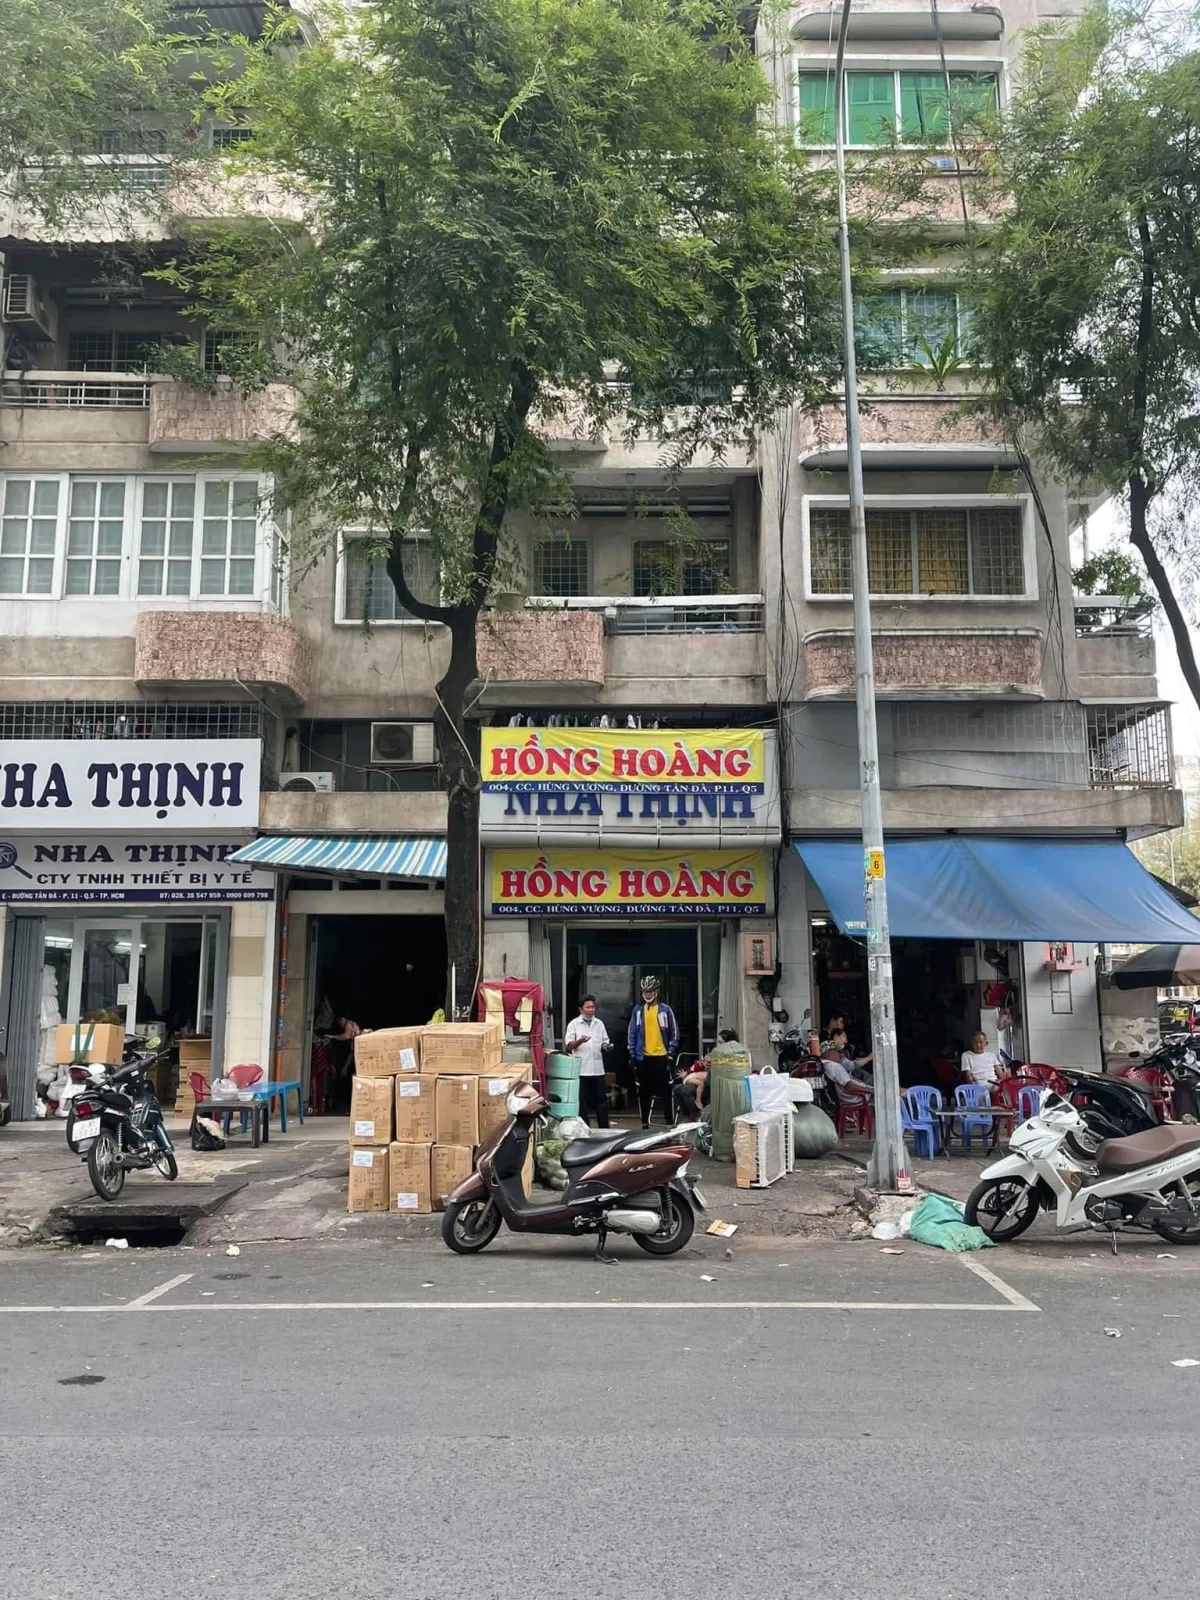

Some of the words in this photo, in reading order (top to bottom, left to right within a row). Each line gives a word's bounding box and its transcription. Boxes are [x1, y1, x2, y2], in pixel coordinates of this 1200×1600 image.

[490, 734, 600, 776] HỒNG
[612, 741, 751, 777] HOÀNG
[0, 763, 72, 807] HA
[88, 763, 244, 819] THỊNH
[538, 782, 570, 791] HÙNG
[664, 783, 688, 792] TẢN
[742, 785, 757, 794] Q5
[34, 845, 114, 863] NHA
[874, 860, 880, 870] 6
[37, 873, 70, 884] CTY
[77, 873, 124, 884] TNHH
[131, 870, 182, 884] THIẾT
[189, 873, 206, 886] BỊ
[214, 873, 225, 884] Y
[231, 870, 253, 884] TẾ
[500, 856, 607, 898] HỒNG
[618, 862, 754, 898] HOÀNG
[547, 904, 578, 913] HÙNG
[669, 903, 693, 913] TẢN
[744, 905, 759, 914] Q5
